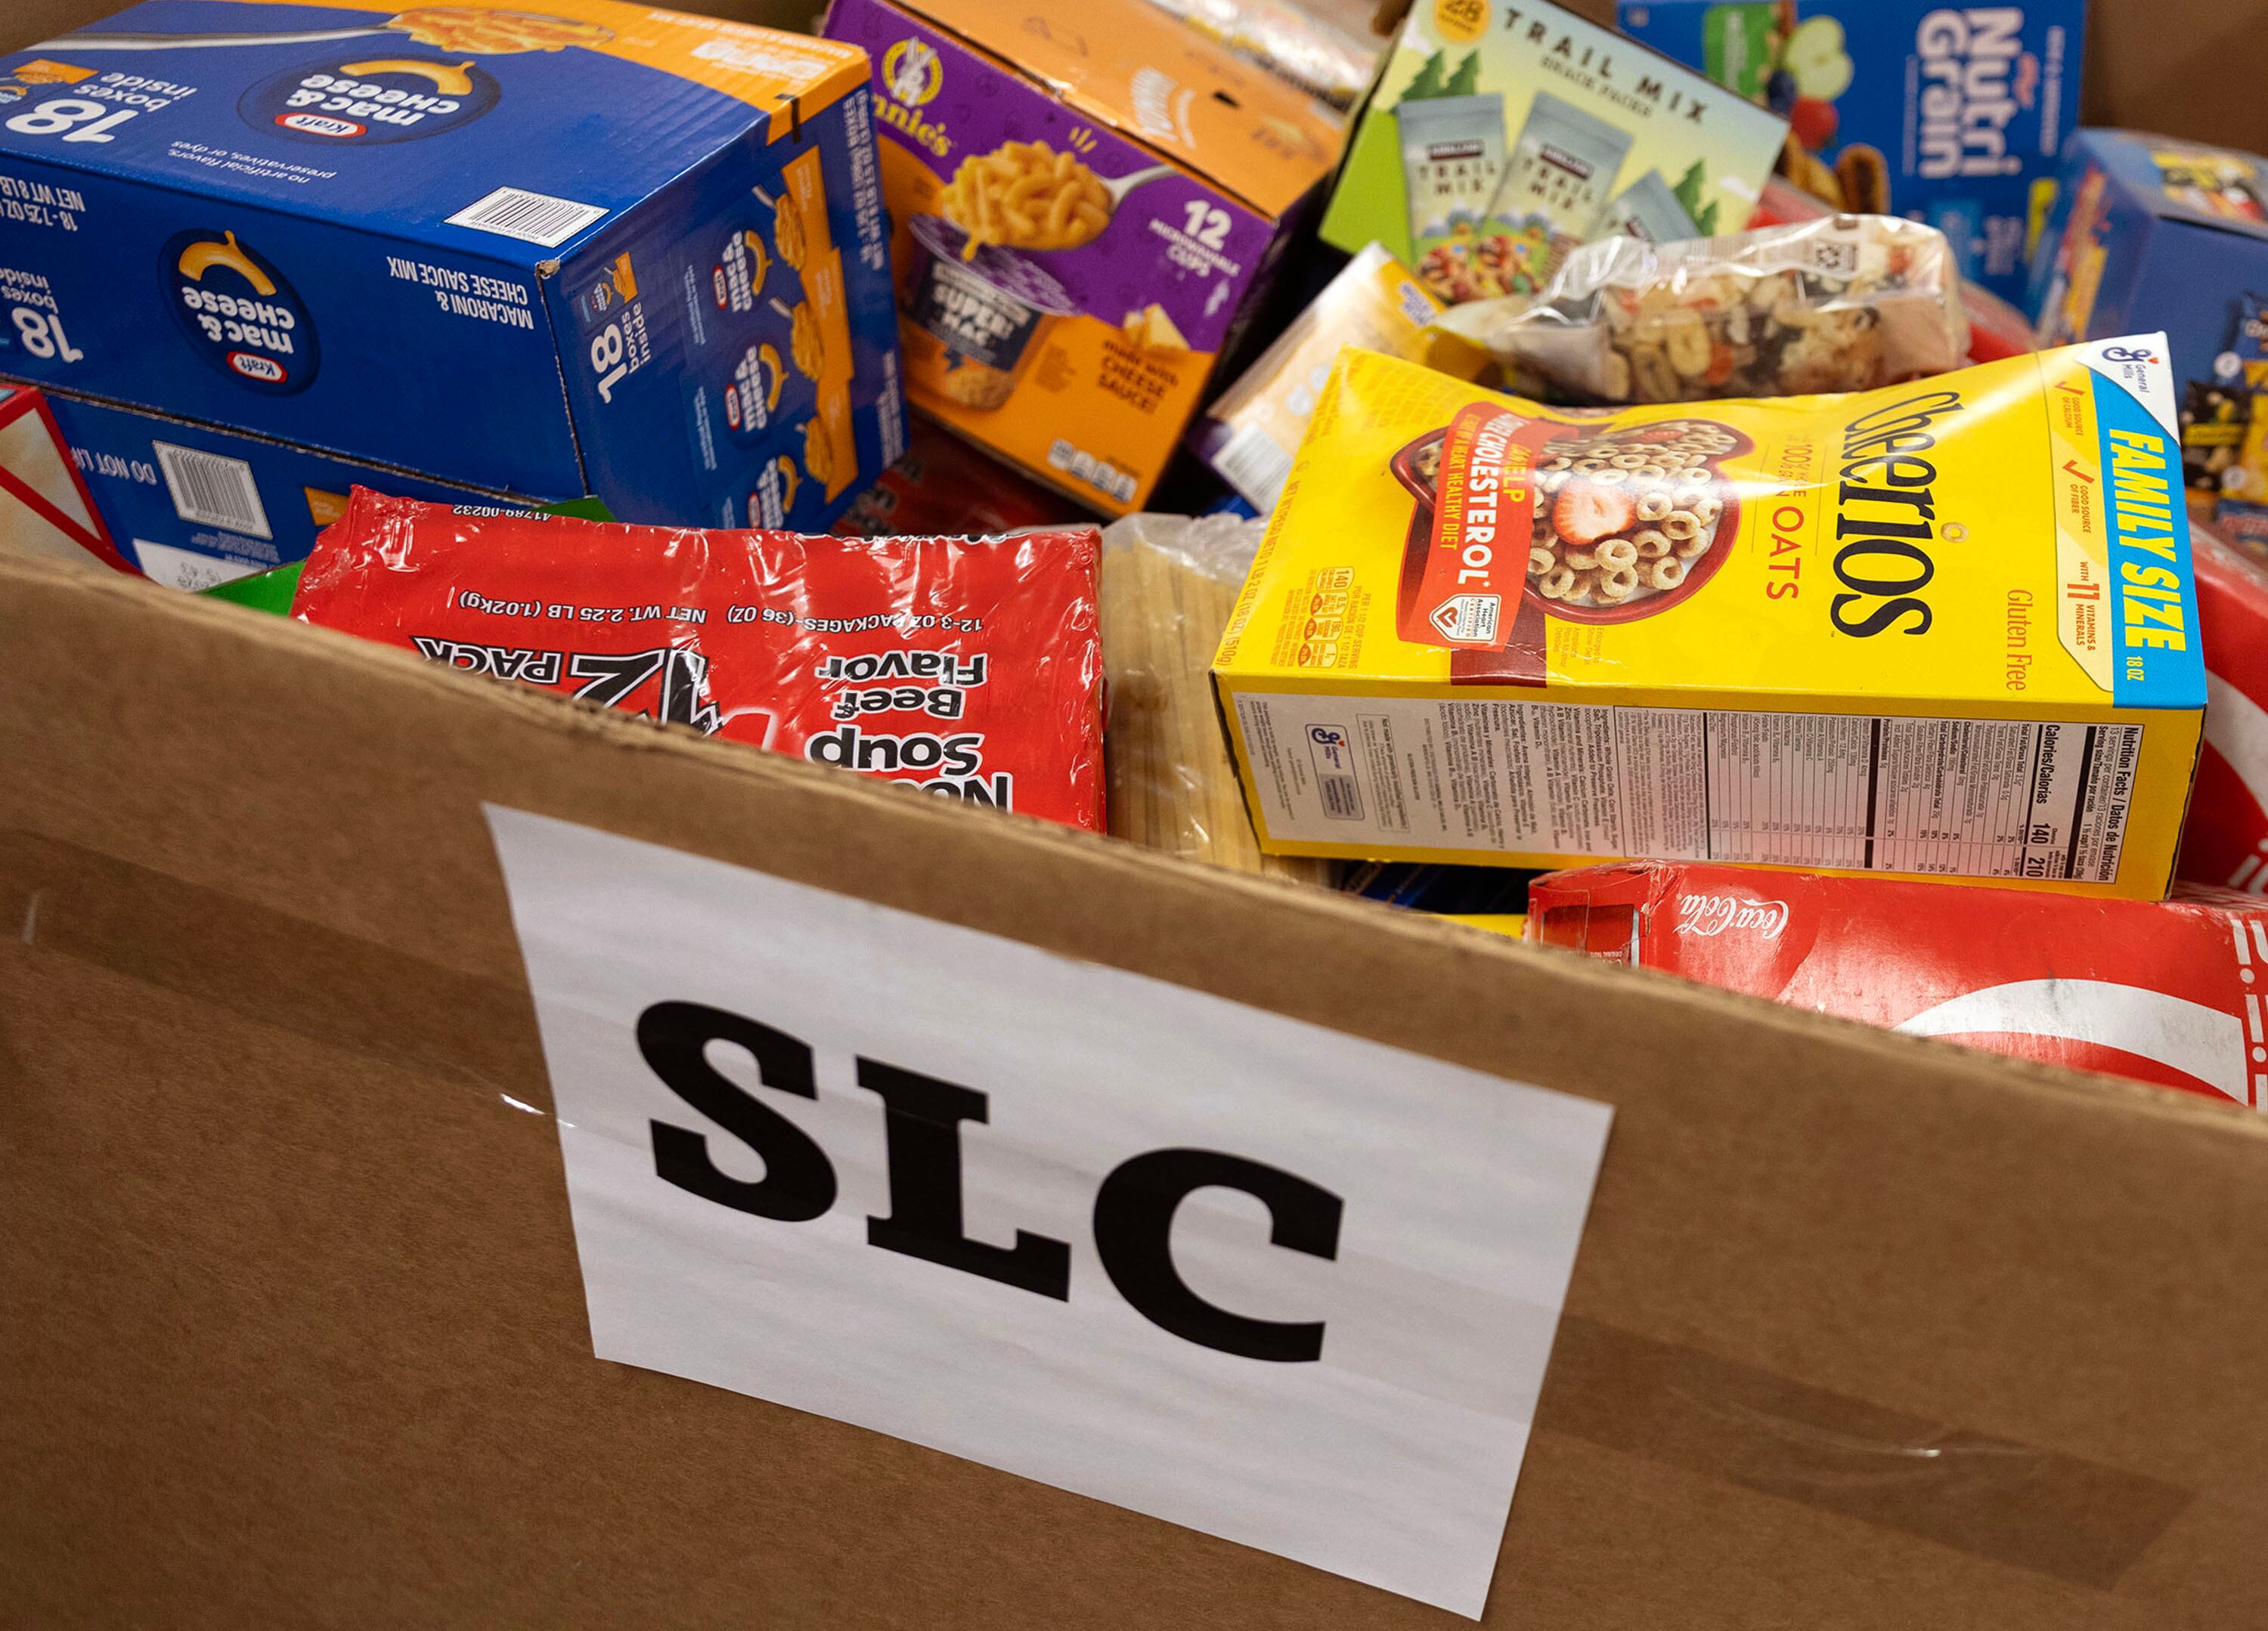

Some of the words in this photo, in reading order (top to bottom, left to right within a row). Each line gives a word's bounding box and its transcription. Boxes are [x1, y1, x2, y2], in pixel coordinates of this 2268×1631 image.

[1504, 8, 1613, 79] TRAIL
[1634, 76, 1708, 123] MIX
[73, 85, 172, 113] boxes
[100, 72, 198, 101] inside
[1915, 9, 1967, 179] Grain
[1964, 6, 2025, 177] Nutri
[5, 99, 139, 143] 18
[295, 116, 350, 135] Kraft
[872, 94, 950, 156] nnie's
[171, 141, 209, 153] dyes
[212, 148, 228, 157] or
[223, 159, 289, 179] artificial
[230, 150, 337, 179] preservatives,
[1418, 163, 1496, 179] TRAIL
[19, 180, 28, 198] 8
[288, 173, 311, 184] no
[1435, 178, 1483, 195] MIX
[31, 181, 55, 206] WT
[57, 187, 85, 212] NET
[2, 198, 24, 219] OZ
[59, 211, 77, 231] 18
[1184, 200, 1232, 250] 12
[386, 255, 419, 283] MIX
[1167, 243, 1210, 277] CUPS
[417, 262, 470, 293] SAUCE
[469, 274, 529, 306] CHEESE
[1, 283, 59, 314] boxes
[434, 289, 450, 311] &
[450, 293, 534, 330] MACARONI
[11, 306, 84, 363] 18
[621, 310, 642, 374] boxes
[631, 302, 652, 365] inside
[238, 354, 277, 376] Kraft
[590, 323, 628, 404] 18
[1103, 337, 1142, 367] made
[1145, 362, 1180, 388] with
[2122, 364, 2135, 379] Mills
[1101, 355, 1165, 400] CHEESE
[2136, 364, 2151, 393] General
[2064, 404, 2074, 429] CALCIUM
[2072, 397, 2081, 414] GOOD
[2074, 414, 2084, 437] SOURCE
[94, 452, 130, 479] NOT
[1448, 444, 1469, 469] HEART
[129, 460, 157, 485] DO
[1502, 460, 1527, 503] HELP
[1287, 481, 1301, 496] NET
[1444, 472, 1464, 520] HEALTHY
[2071, 484, 2079, 493] OF
[2080, 485, 2090, 506] GOOD
[2108, 428, 2177, 563] FAMILY
[1830, 391, 1966, 639] Cheerios
[2071, 494, 2081, 514] FIBER
[2081, 506, 2092, 534] SOURCE
[1439, 523, 1461, 551] DIET
[1765, 505, 1805, 600] OATS
[1252, 567, 1265, 580] LB
[1334, 569, 1349, 588] 140
[2080, 562, 2090, 582] WITH
[458, 590, 541, 618] (1.02kg)
[1243, 588, 1259, 600] OZ
[1352, 586, 1362, 599] POR
[2067, 583, 2100, 601] 11
[547, 603, 575, 620] LB
[579, 606, 624, 623] 2.25
[627, 605, 662, 622] WT.
[665, 605, 708, 624] NET
[727, 605, 758, 624] OZ)
[1236, 602, 1251, 617] (18
[1473, 598, 1483, 638] Association
[1479, 608, 1489, 628] Heart
[1486, 602, 1496, 635] American
[2006, 588, 2034, 648] Gluten
[2120, 561, 2187, 652] SIZE
[909, 612, 936, 629] OZ
[940, 613, 984, 633] 12-3
[1228, 616, 1247, 636] OZ)
[1343, 624, 1354, 634] DE
[1356, 624, 1365, 638] CUP
[2076, 604, 2086, 646] MINERALS
[2087, 604, 2096, 645] VITAMINS
[409, 636, 563, 684] PACK
[1216, 636, 1241, 667] (510g)
[1337, 653, 1349, 669] TAZA
[1349, 639, 1362, 669] SERVING
[2125, 655, 2144, 667] 18
[814, 650, 988, 687] Flavor
[2005, 652, 2033, 692] Free
[2126, 669, 2146, 682] OZ
[830, 686, 967, 720] Beef
[2094, 726, 2109, 748] Serving
[2104, 735, 2118, 762] servings
[2118, 726, 2139, 769] Nutrition
[2035, 723, 2061, 805] Calories/Calorías
[2104, 762, 2113, 773] per
[2088, 785, 2097, 796] por
[2113, 770, 2132, 800] Facts
[2108, 805, 2126, 831] Datos
[2030, 822, 2052, 844] 140
[2105, 831, 2120, 843] de
[2025, 857, 2046, 878] 210
[2097, 843, 2118, 882] Nutrición
[1672, 893, 1789, 939] Coca-Cola
[634, 998, 1346, 1364] SLC
